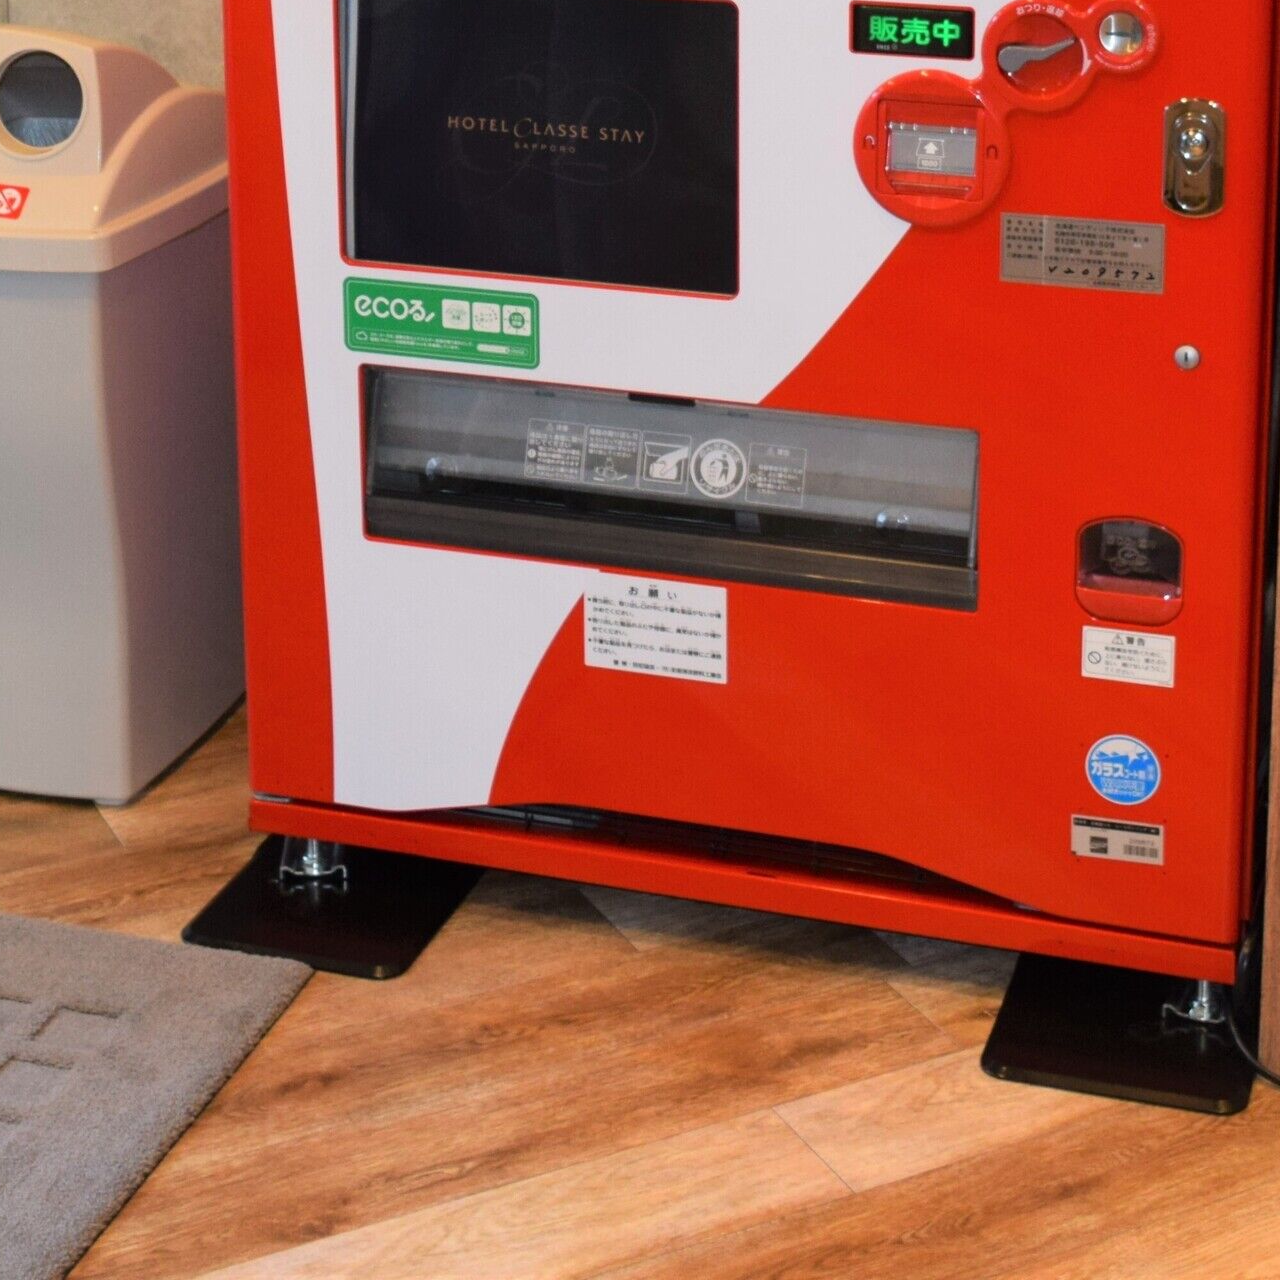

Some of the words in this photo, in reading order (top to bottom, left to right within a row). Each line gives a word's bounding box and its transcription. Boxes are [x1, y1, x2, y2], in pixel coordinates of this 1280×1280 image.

[869, 15, 961, 48] 販売中
[447, 116, 509, 133] HOTEL
[599, 127, 645, 144] STAY
[513, 142, 576, 154] SAPPORO
[628, 584, 678, 600] お願い
